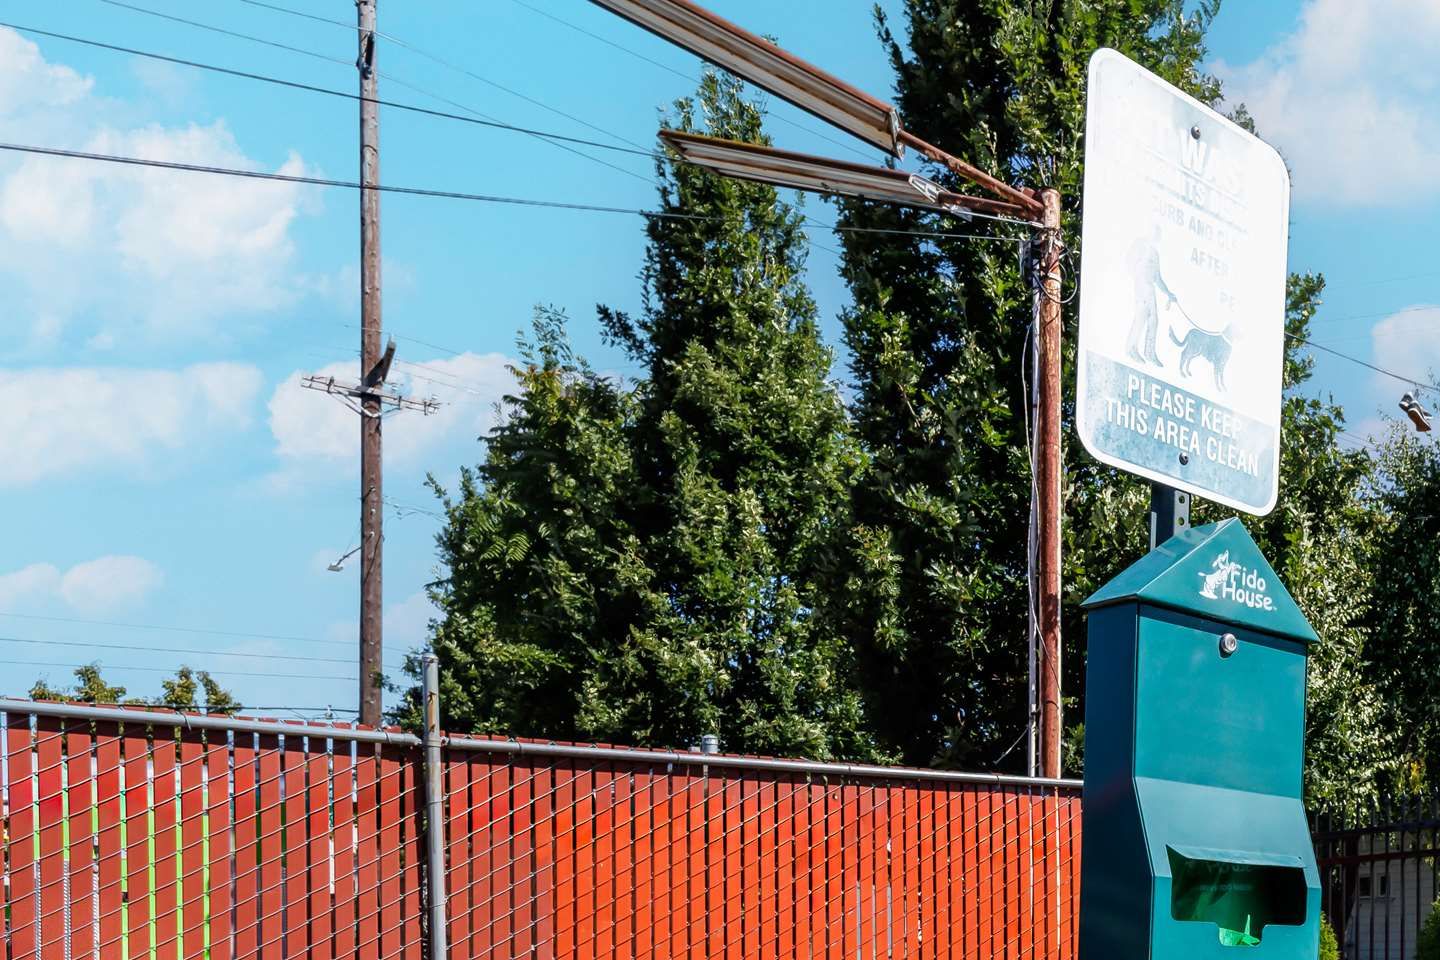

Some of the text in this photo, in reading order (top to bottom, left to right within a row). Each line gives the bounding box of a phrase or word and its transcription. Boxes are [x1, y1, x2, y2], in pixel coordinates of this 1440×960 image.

[1127, 374, 1243, 441] PLEASE KEEP
[1103, 399, 1259, 477] THIS AREA CLEAN
[1222, 581, 1273, 611] House
[1230, 562, 1267, 591] Fido
